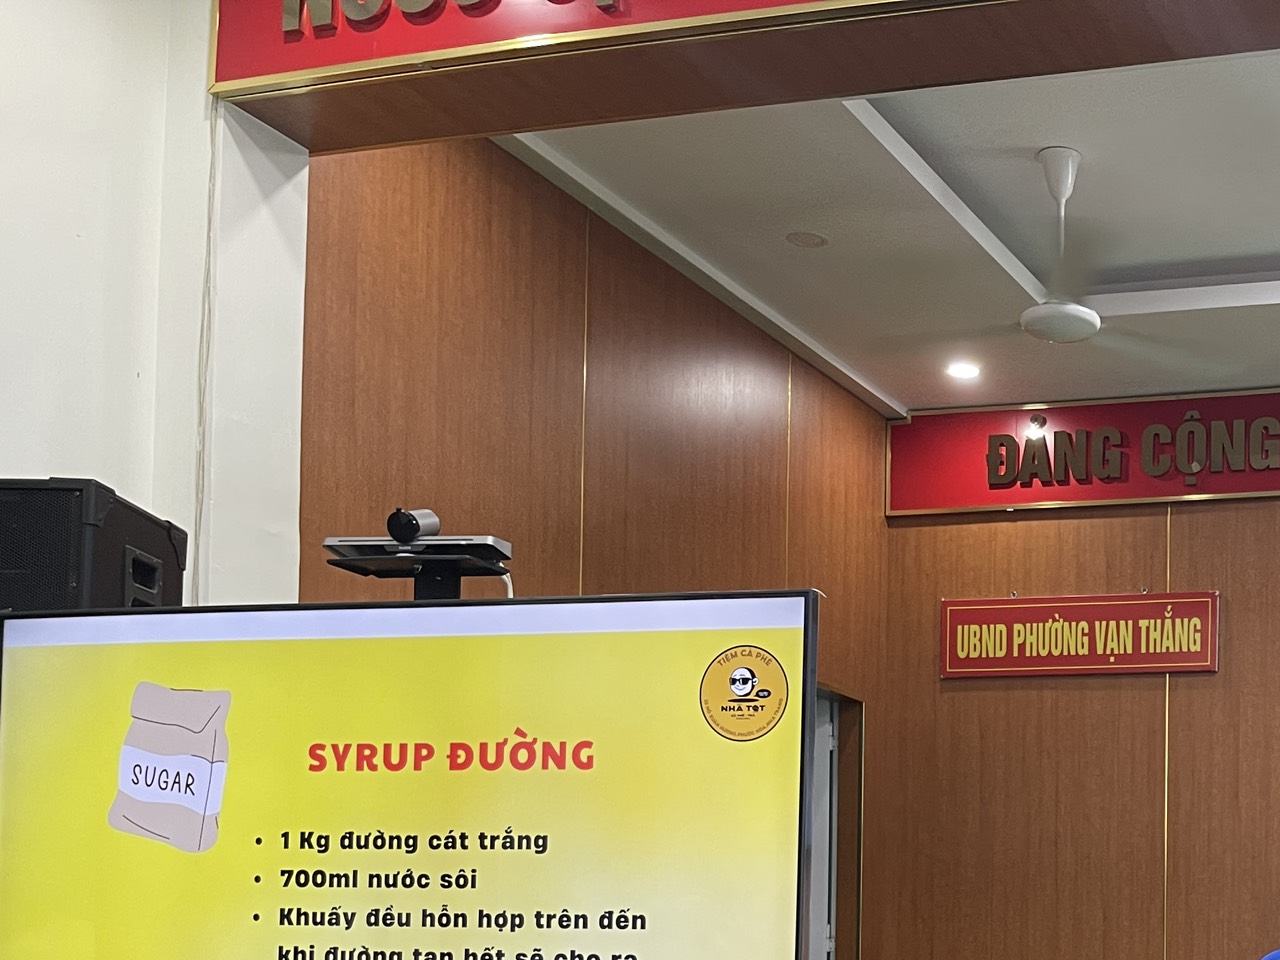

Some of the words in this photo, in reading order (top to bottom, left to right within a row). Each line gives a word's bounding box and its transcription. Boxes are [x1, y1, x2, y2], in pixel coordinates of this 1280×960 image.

[986, 414, 1122, 489] ĐẢNG
[956, 624, 1007, 659] UBND
[1013, 613, 1089, 657] PHƯỜNG
[1094, 620, 1133, 662] VẠN
[1138, 605, 1201, 654] THẮNG
[308, 743, 435, 772] SYRUP
[446, 727, 594, 771] ĐƯỜNG
[131, 763, 196, 797] SUGAR
[280, 832, 290, 849] 1
[299, 831, 330, 853] Kg
[339, 829, 418, 854] đường
[428, 828, 469, 850] cát
[478, 826, 548, 854] trắng
[280, 869, 358, 889] 700ml
[368, 869, 431, 889] nước
[439, 869, 477, 889] sôi
[278, 905, 356, 930] Khuấy
[366, 905, 412, 928] đều
[421, 904, 468, 929] hỗn
[477, 909, 525, 932] hợp
[534, 909, 588, 930] trên
[599, 908, 647, 930] đến
